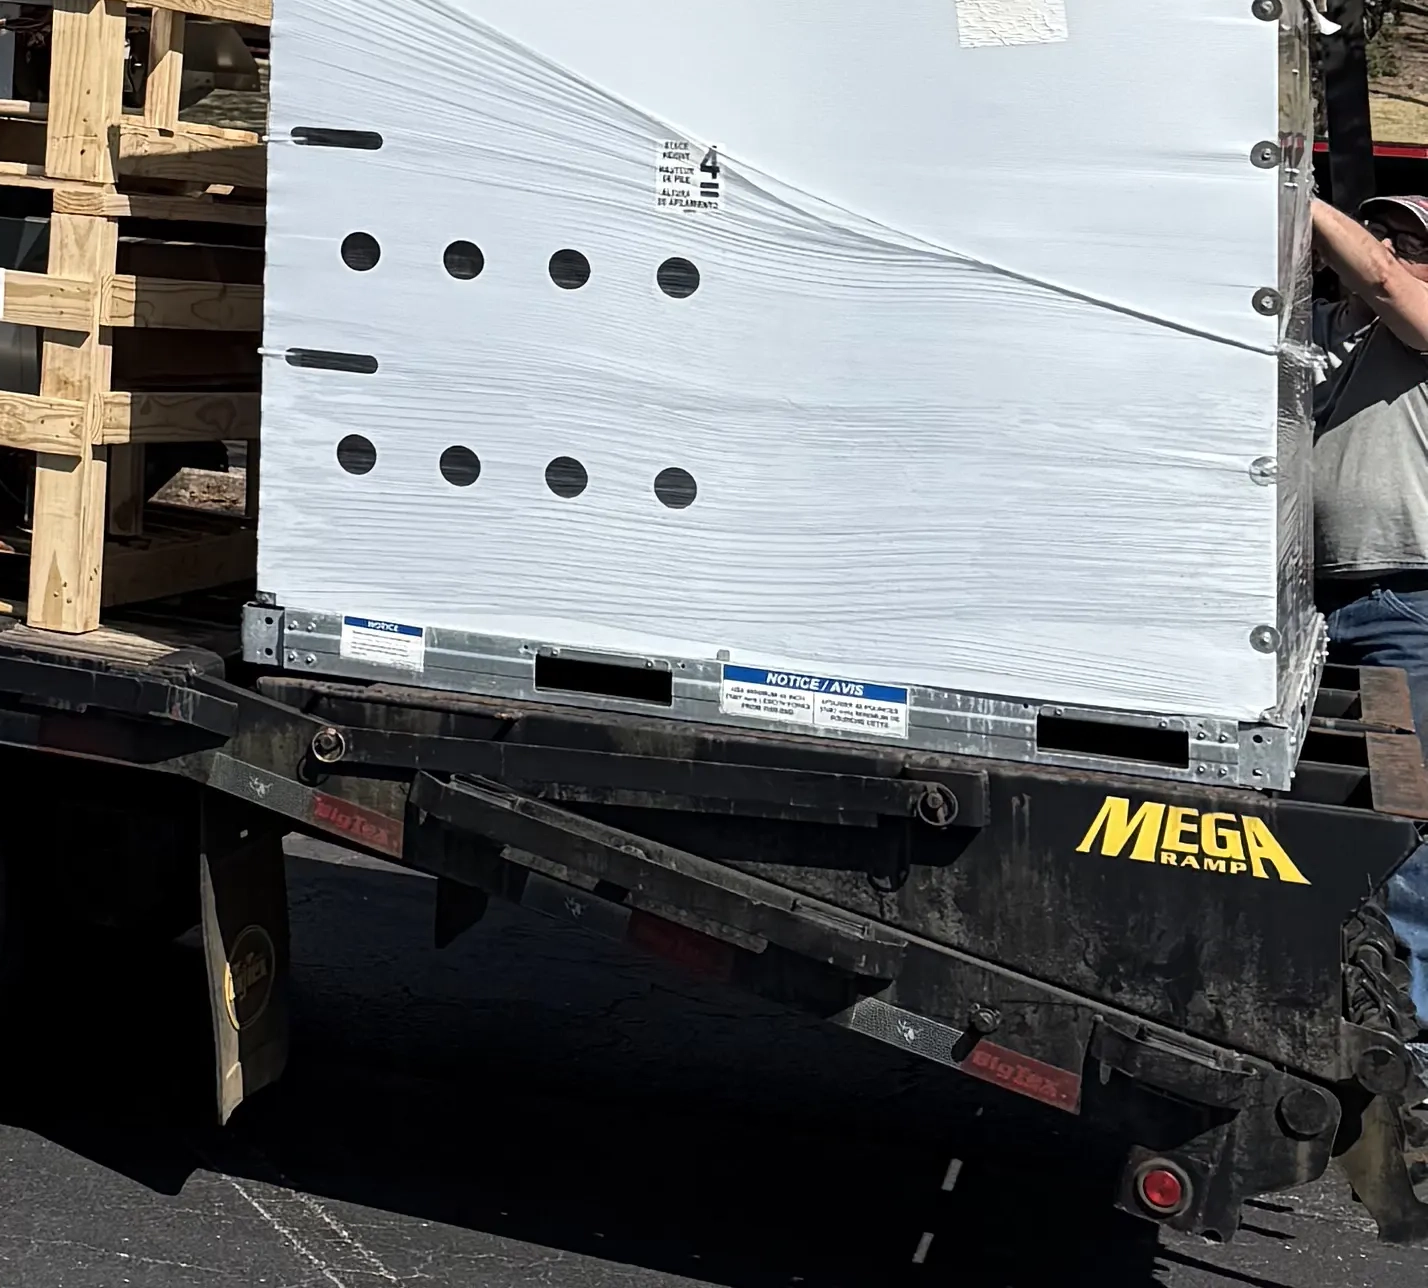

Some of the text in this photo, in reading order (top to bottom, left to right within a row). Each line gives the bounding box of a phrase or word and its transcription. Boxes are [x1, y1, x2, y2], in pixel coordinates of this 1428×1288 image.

[700, 145, 720, 179] 4
[766, 673, 820, 690] NOTICE
[829, 680, 865, 696] AVIS
[1076, 795, 1312, 886] MEGA
[1160, 850, 1248, 875] RAMP
